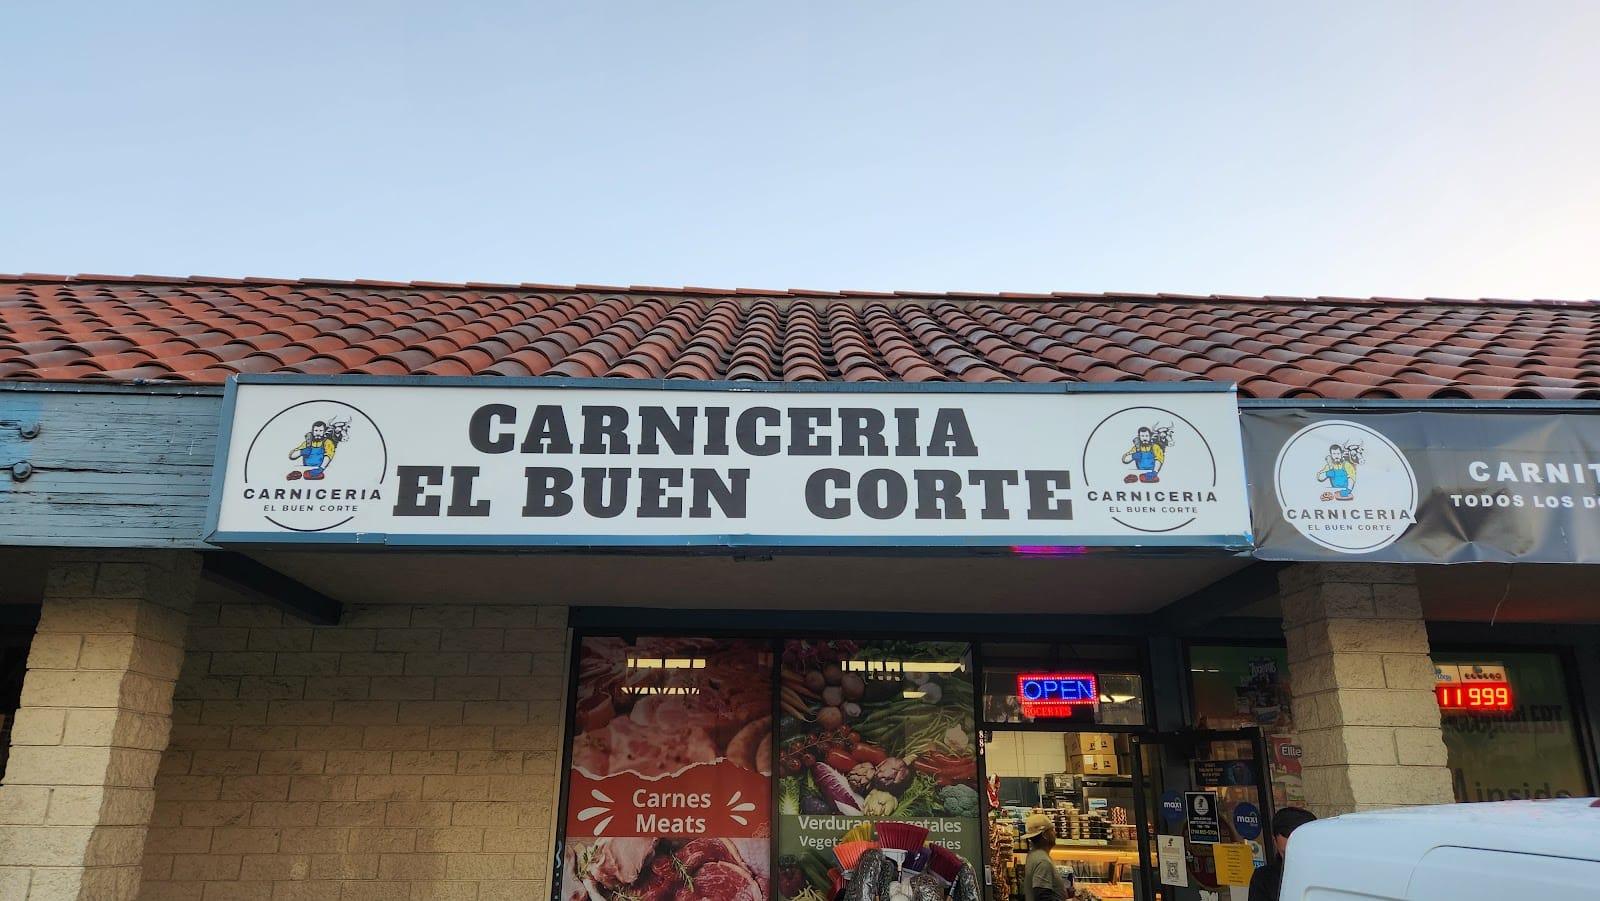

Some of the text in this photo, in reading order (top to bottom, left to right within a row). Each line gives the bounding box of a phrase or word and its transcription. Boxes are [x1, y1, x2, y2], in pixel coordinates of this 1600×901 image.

[468, 403, 979, 457] CARNICERIA
[1468, 461, 1600, 483] CARNIT
[243, 488, 381, 500] CARNICERIA
[392, 465, 1073, 521] EL BUEN CORTE
[1087, 491, 1217, 502] CARNICERIA
[263, 504, 358, 512] EL BUEN CORTE
[1450, 494, 1600, 509] TODOS LOS D
[1161, 506, 1198, 514] CORTE
[1287, 509, 1410, 520] CARNICERIA
[1023, 680, 1094, 700] OPEN
[632, 788, 712, 808] Carnes
[636, 813, 706, 833] Meats
[886, 817, 962, 833] etales
[1236, 814, 1258, 824] maxi
